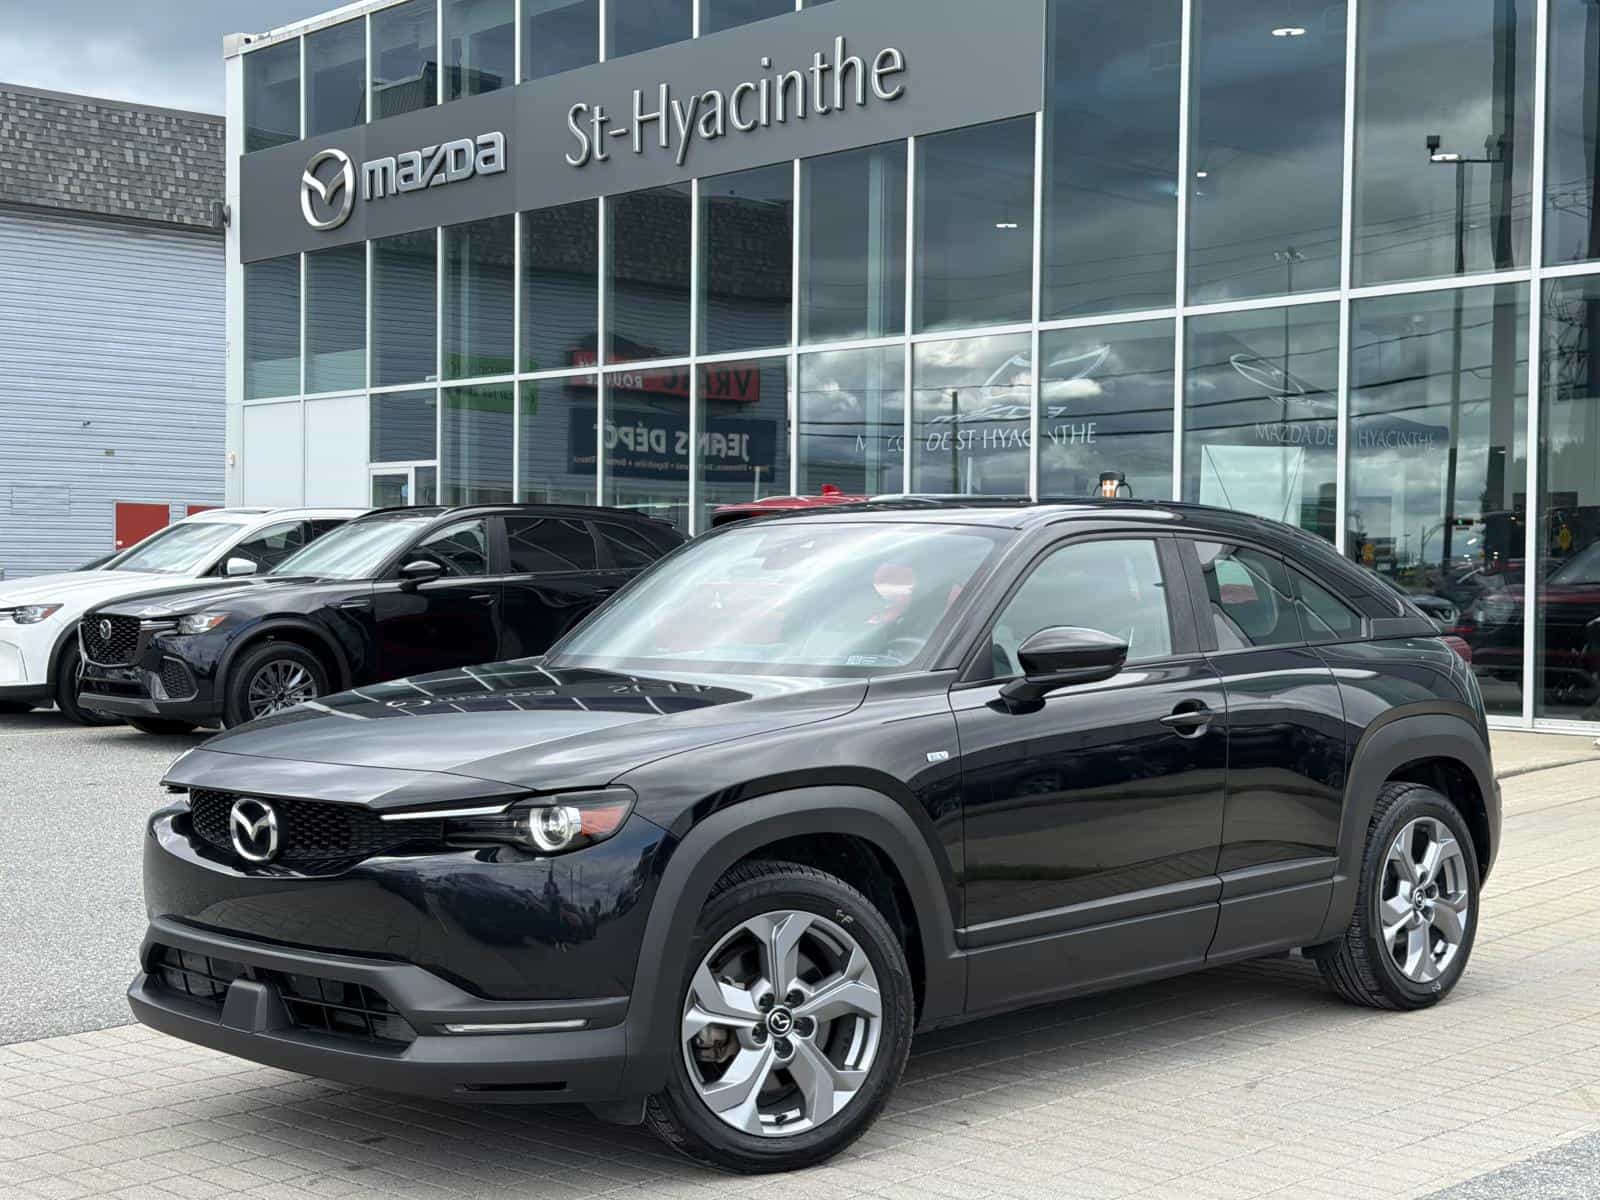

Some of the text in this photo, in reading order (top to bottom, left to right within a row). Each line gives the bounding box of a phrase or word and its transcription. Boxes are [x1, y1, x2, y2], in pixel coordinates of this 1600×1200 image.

[565, 36, 906, 167] St-Hyacinthe
[926, 431, 951, 452] DE
[956, 422, 1097, 450] ST-HYACNTHE
[1254, 423, 1312, 445] MAZDA
[1315, 426, 1336, 447] DE
